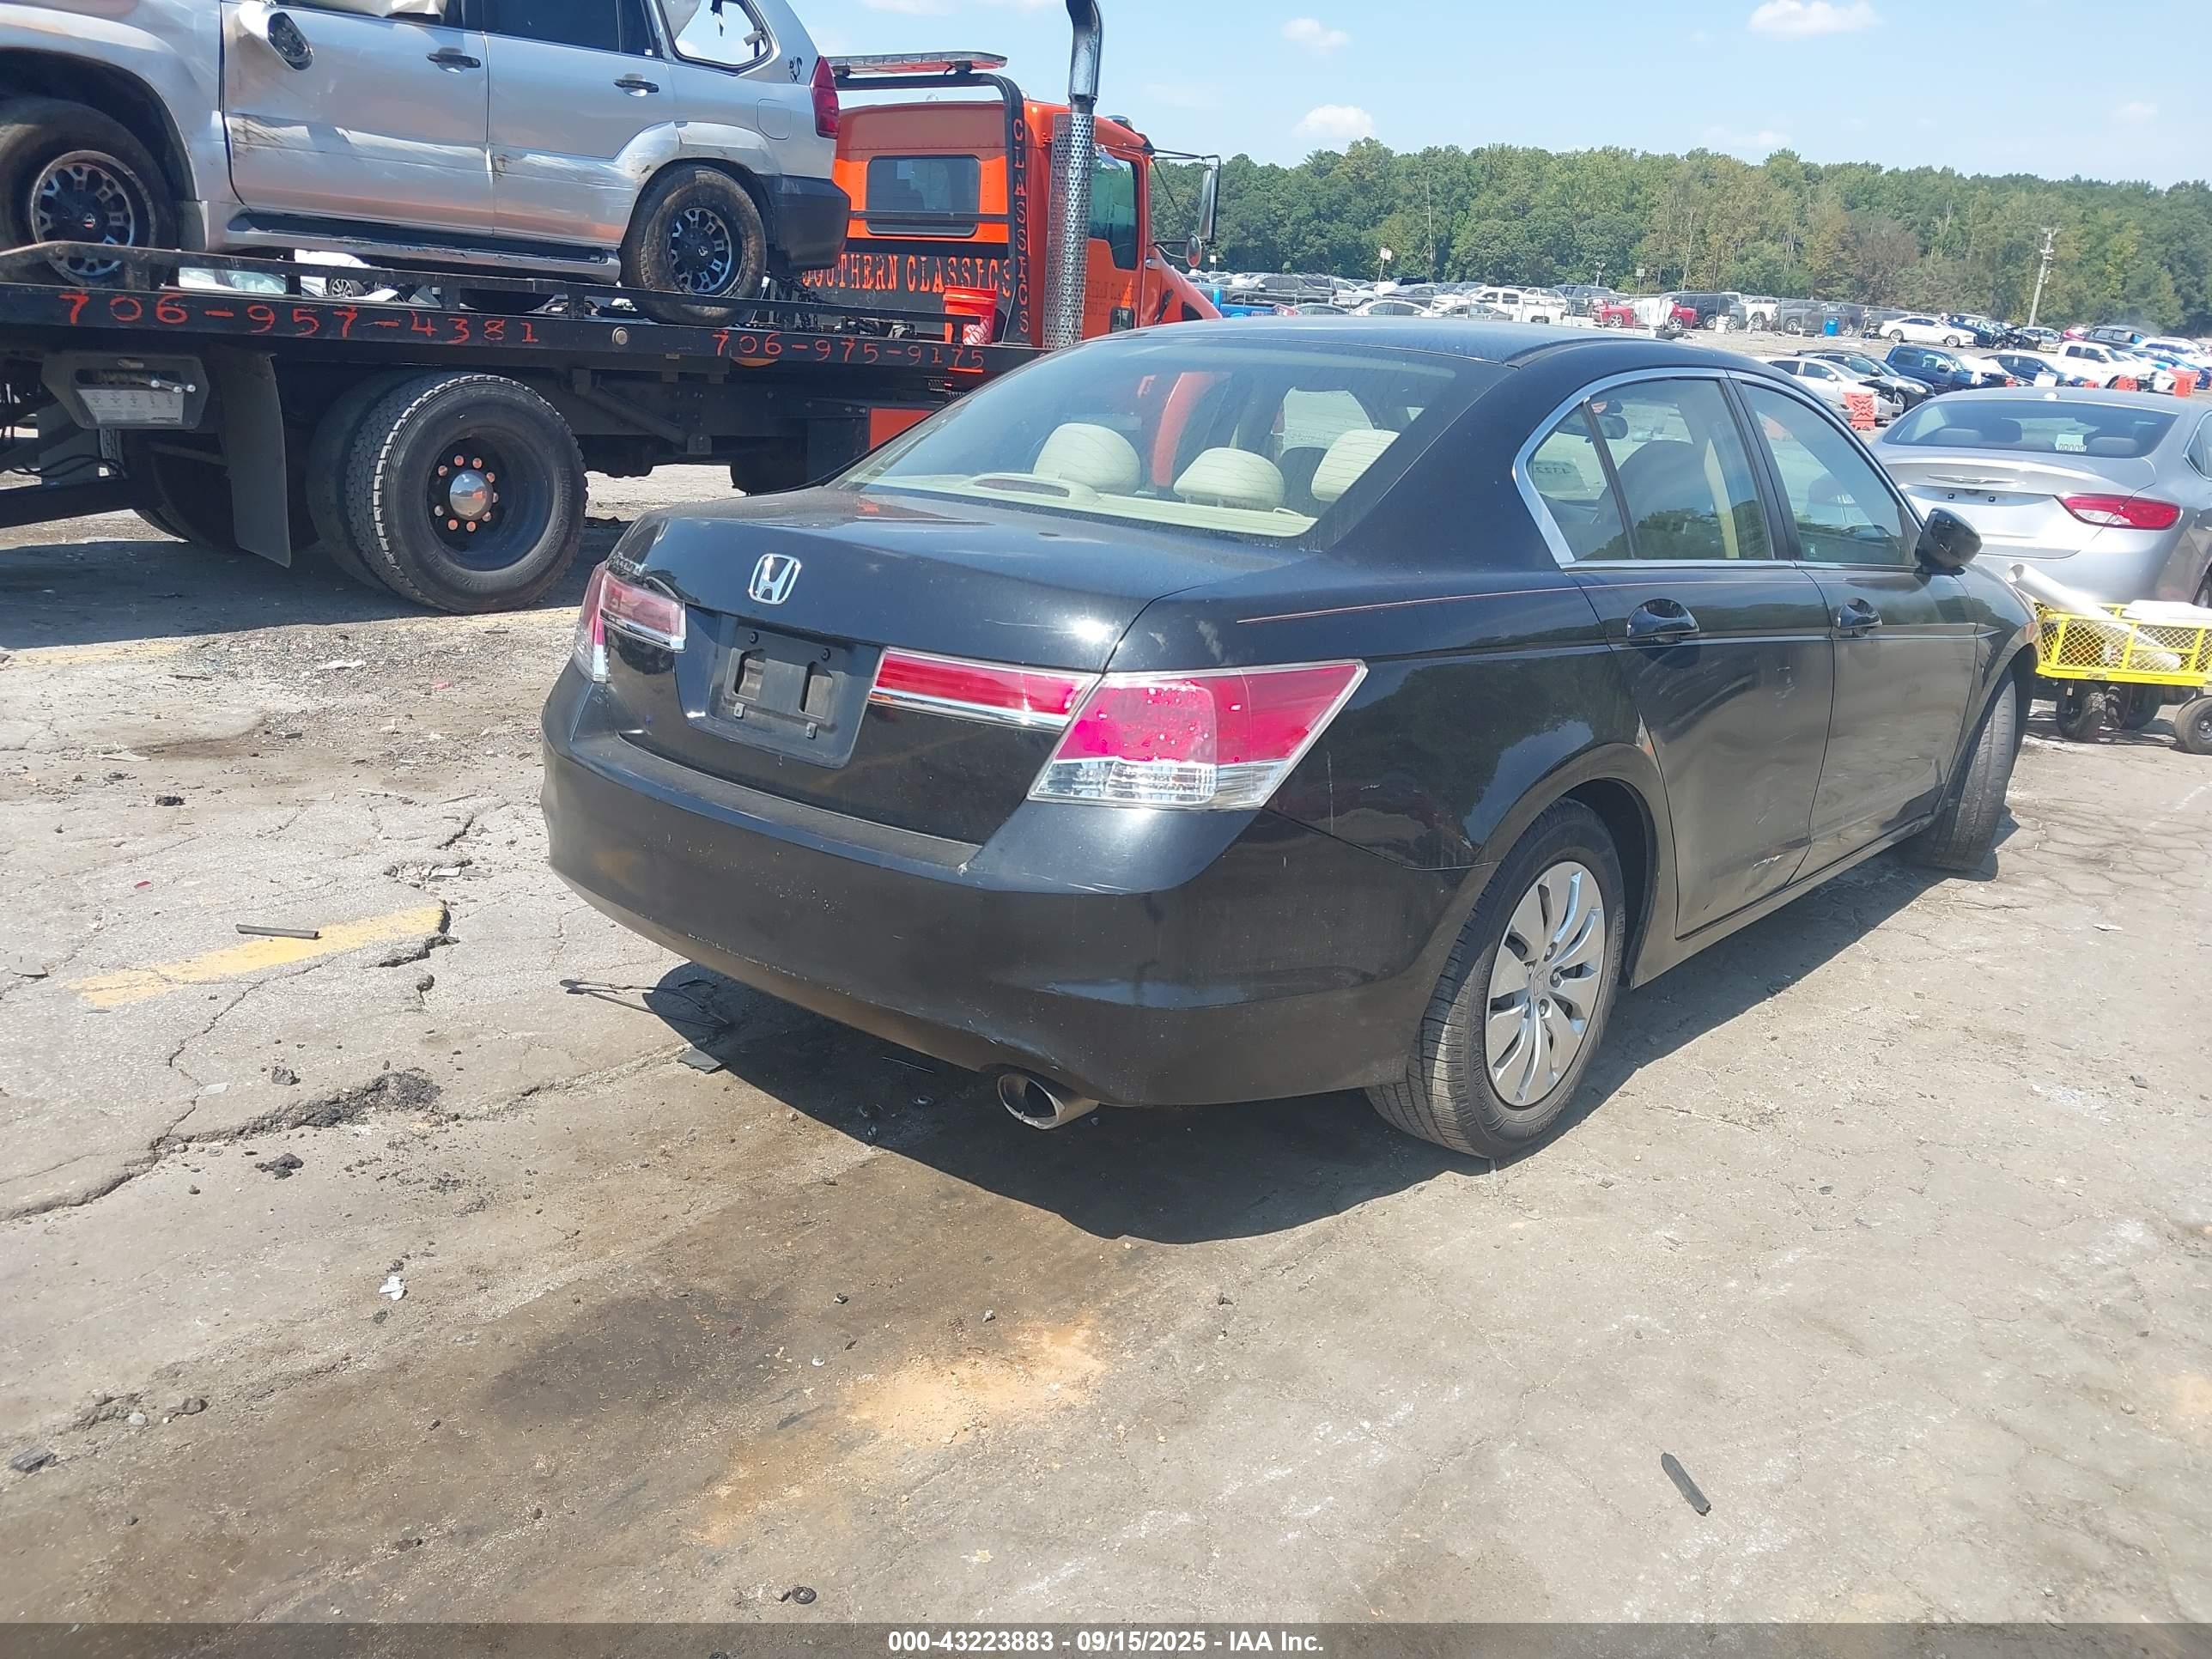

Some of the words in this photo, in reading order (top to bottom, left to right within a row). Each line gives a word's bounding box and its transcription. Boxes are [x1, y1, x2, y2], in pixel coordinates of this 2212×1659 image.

[1012, 118, 1030, 333] CLASSICS
[59, 291, 539, 343] 706-957-4381
[712, 330, 985, 370] 706-975-9175
